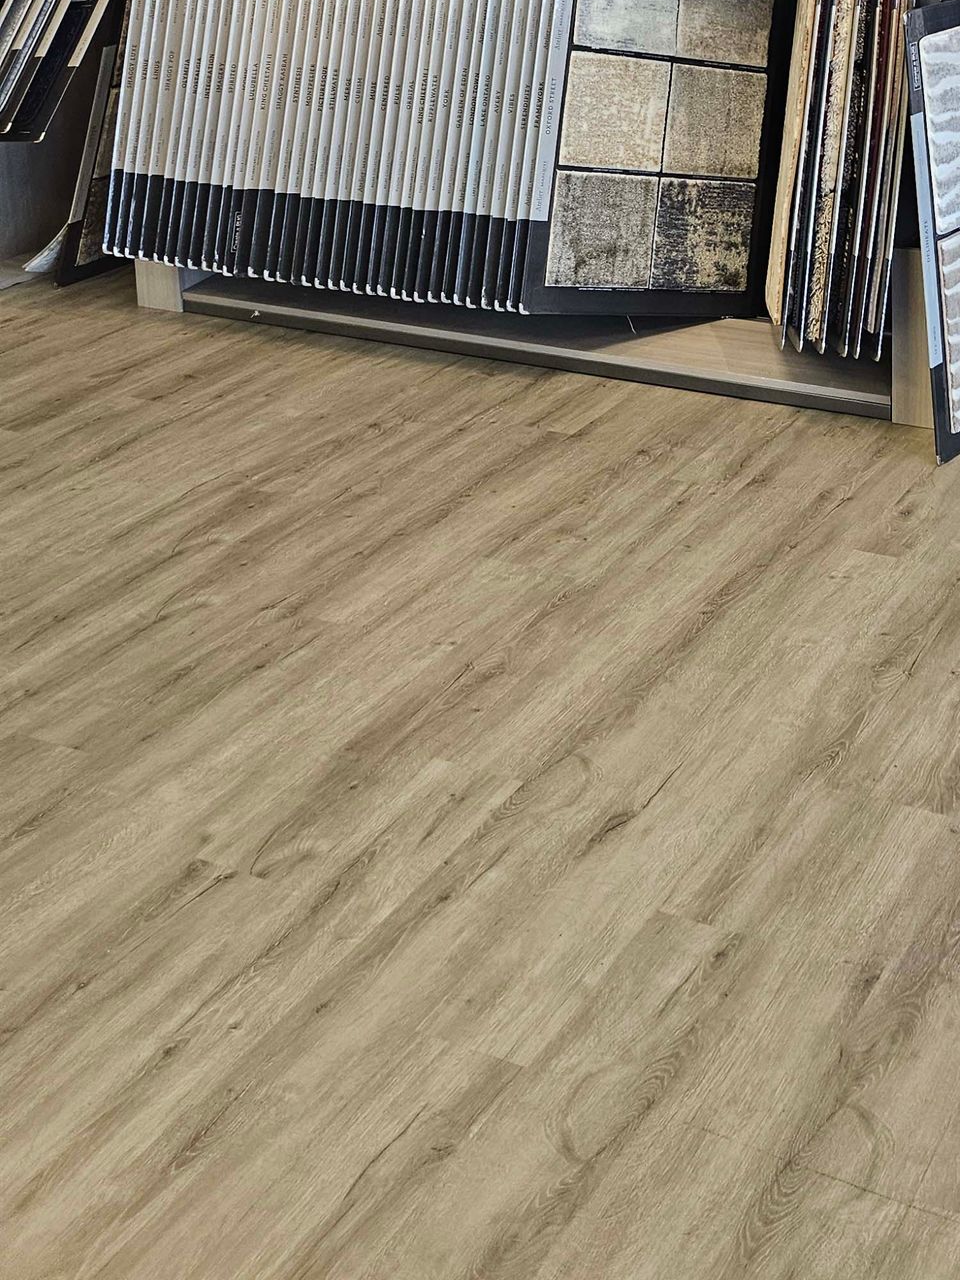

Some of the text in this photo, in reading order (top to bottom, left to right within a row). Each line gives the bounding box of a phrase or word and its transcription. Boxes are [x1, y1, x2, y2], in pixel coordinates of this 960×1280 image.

[127, 45, 138, 89] SHAGGY LUXE
[152, 60, 160, 80] LINUS
[165, 65, 173, 91] SHAGGY
[181, 58, 190, 88] OLYMPIA
[204, 53, 215, 99] INTEGRATION
[216, 63, 225, 93] IMAGERY
[249, 63, 259, 101] LULUBELLA
[263, 61, 272, 92] CHEETAH
[276, 53, 288, 110] SHAGGY KASBAH
[293, 66, 303, 103] SYNTHESIS
[305, 64, 315, 107] MONTPELIER
[317, 65, 328, 112] PICTURESQUE
[329, 69, 338, 111] STILLWATER
[355, 78, 363, 104] CUBISM
[369, 81, 377, 100] MUSE
[380, 75, 390, 111] CENTERED
[406, 80, 415, 110] ORBITAL
[419, 72, 428, 105] CHEETAH
[428, 74, 438, 123] RIPPLEWATER
[442, 89, 450, 109] YORK
[482, 74, 490, 107] ONTARIO
[260, 93, 268, 110] KING
[456, 99, 464, 129] GARDEN
[460, 90, 466, 98] OF
[469, 96, 477, 126] LONDON
[494, 90, 502, 114] AVERY
[507, 93, 515, 114] VIBES
[520, 83, 531, 130] SERENDIPITY
[534, 81, 544, 128] FRAMEWORK
[545, 77, 557, 135] OXFORD STREET
